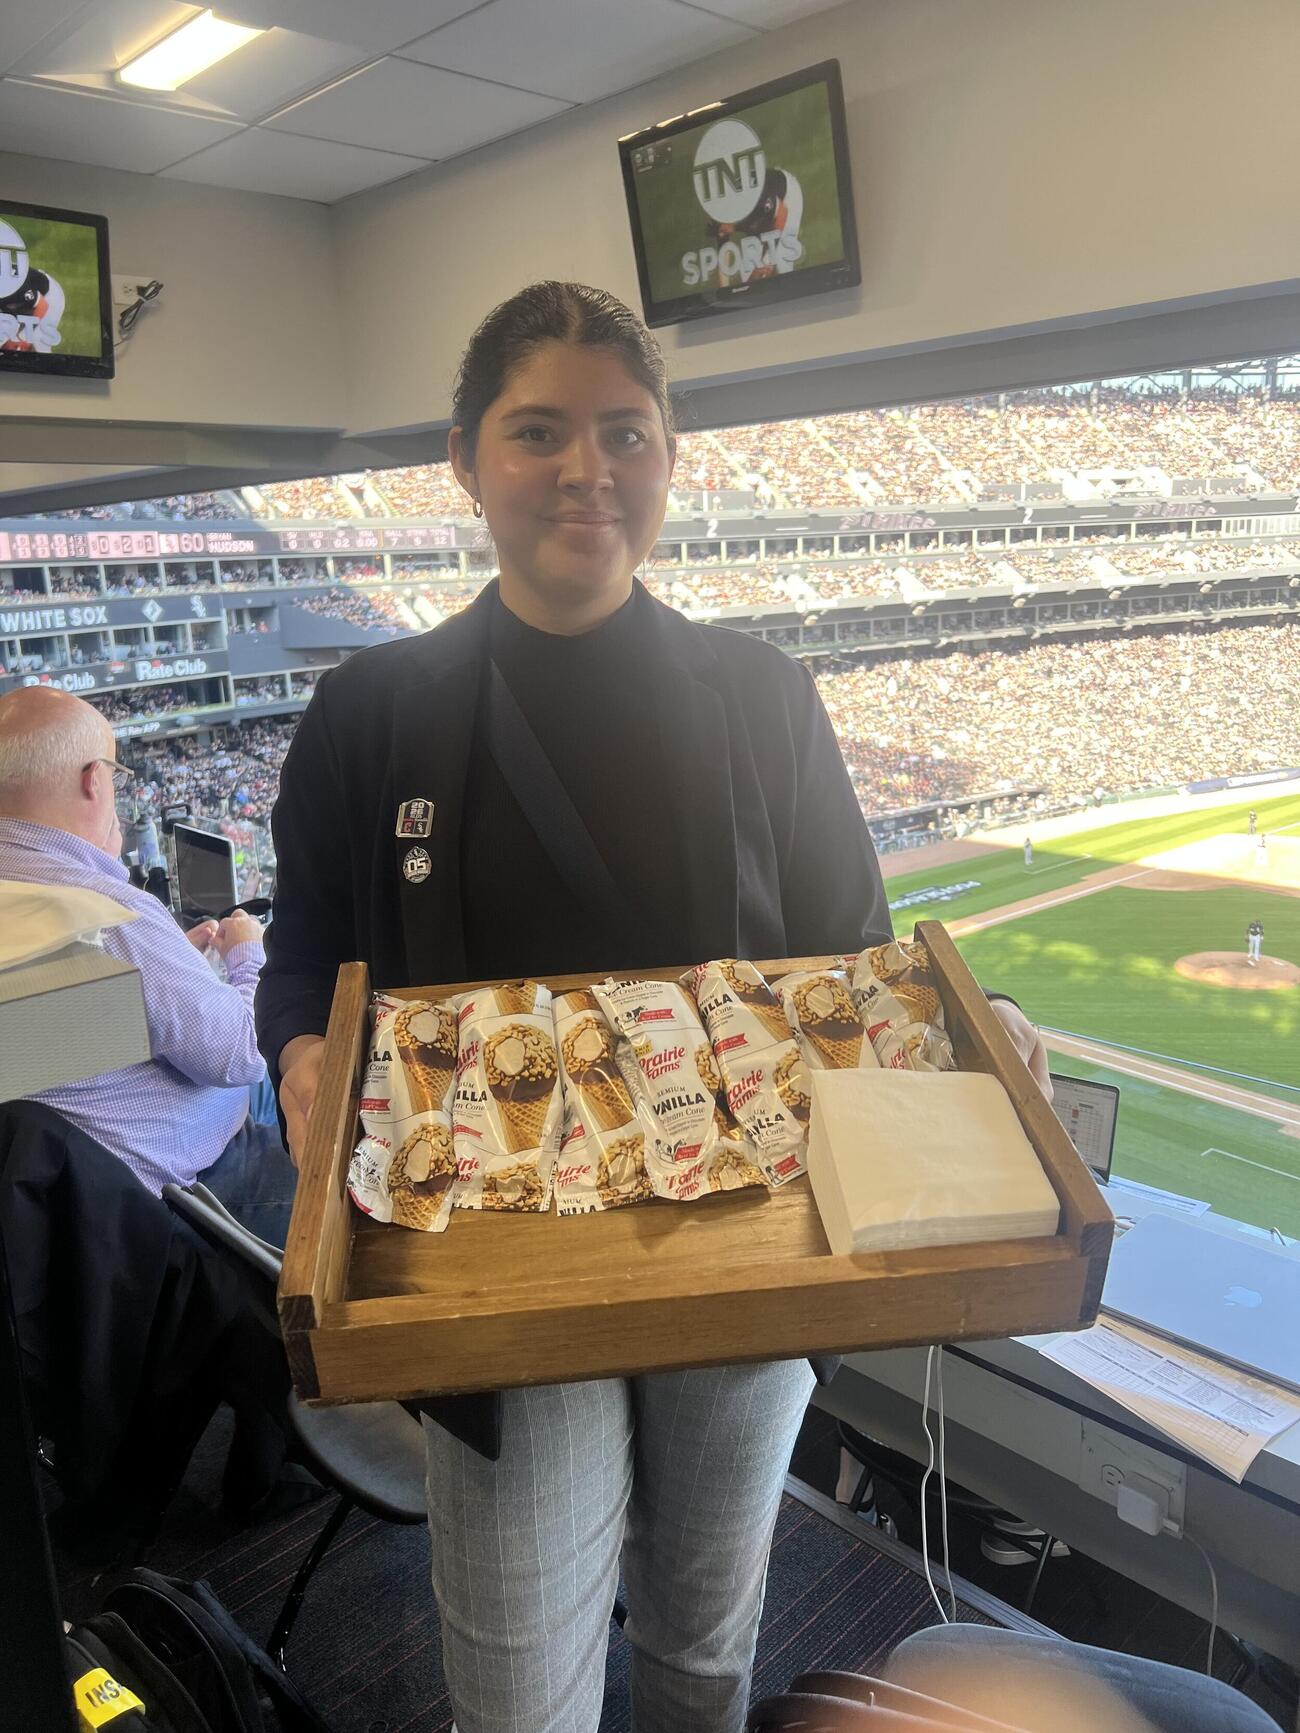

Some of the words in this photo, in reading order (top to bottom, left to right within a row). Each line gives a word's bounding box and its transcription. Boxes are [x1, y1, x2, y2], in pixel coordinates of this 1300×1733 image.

[692, 147, 766, 203] TNT
[681, 229, 805, 286] SPORTS
[1022, 507, 1035, 525] 2
[706, 517, 719, 538] 2
[120, 535, 133, 553] 2
[180, 533, 205, 553] 60
[208, 540, 254, 554] HUDSON
[0, 608, 67, 632] WHITE
[69, 606, 108, 626] SOX
[135, 659, 173, 681] Rate
[172, 658, 207, 677] Club
[62, 672, 96, 691] Club
[407, 858, 426, 873] 05
[85, 1679, 122, 1708] INS
